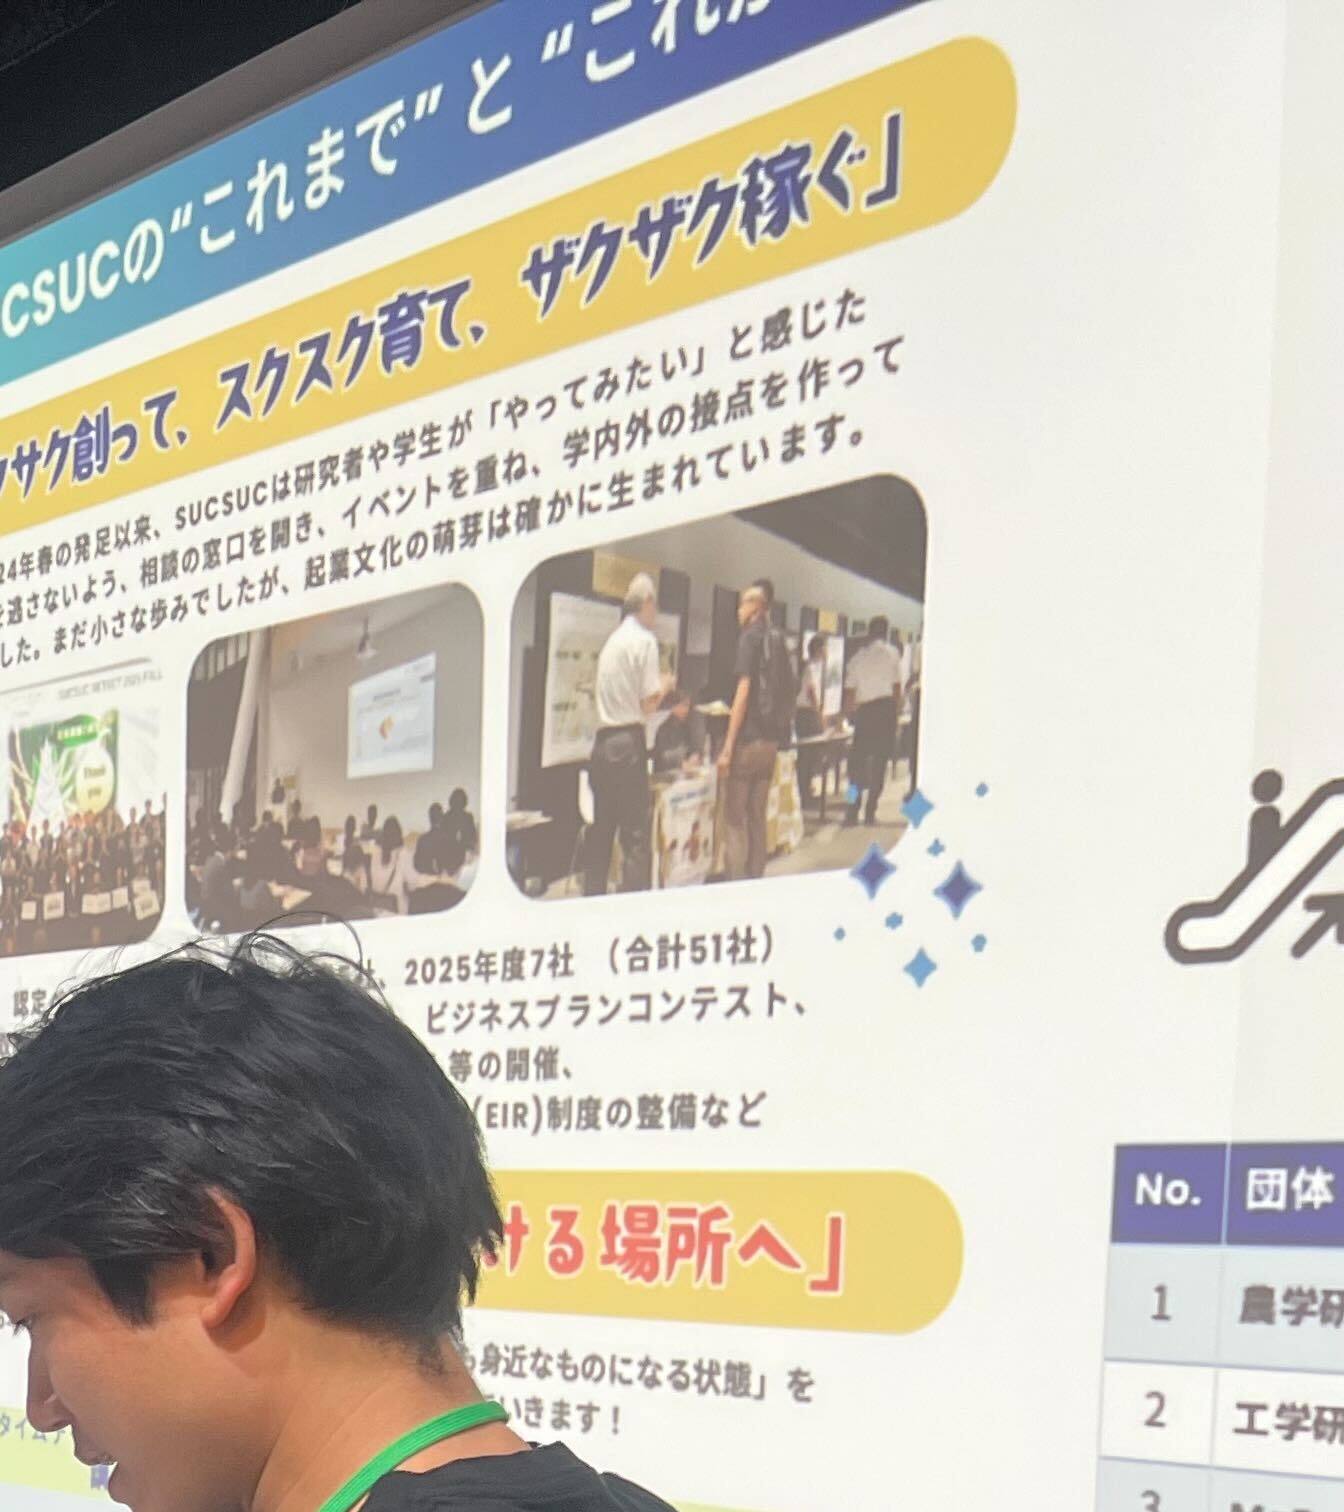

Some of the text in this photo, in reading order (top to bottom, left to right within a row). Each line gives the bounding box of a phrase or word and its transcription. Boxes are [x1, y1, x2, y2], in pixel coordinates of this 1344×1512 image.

[1134, 1171, 1202, 1206] No.
[1245, 1165, 1335, 1212] 団体
[1150, 1283, 1172, 1322] 1
[1143, 1390, 1167, 1428] 2
